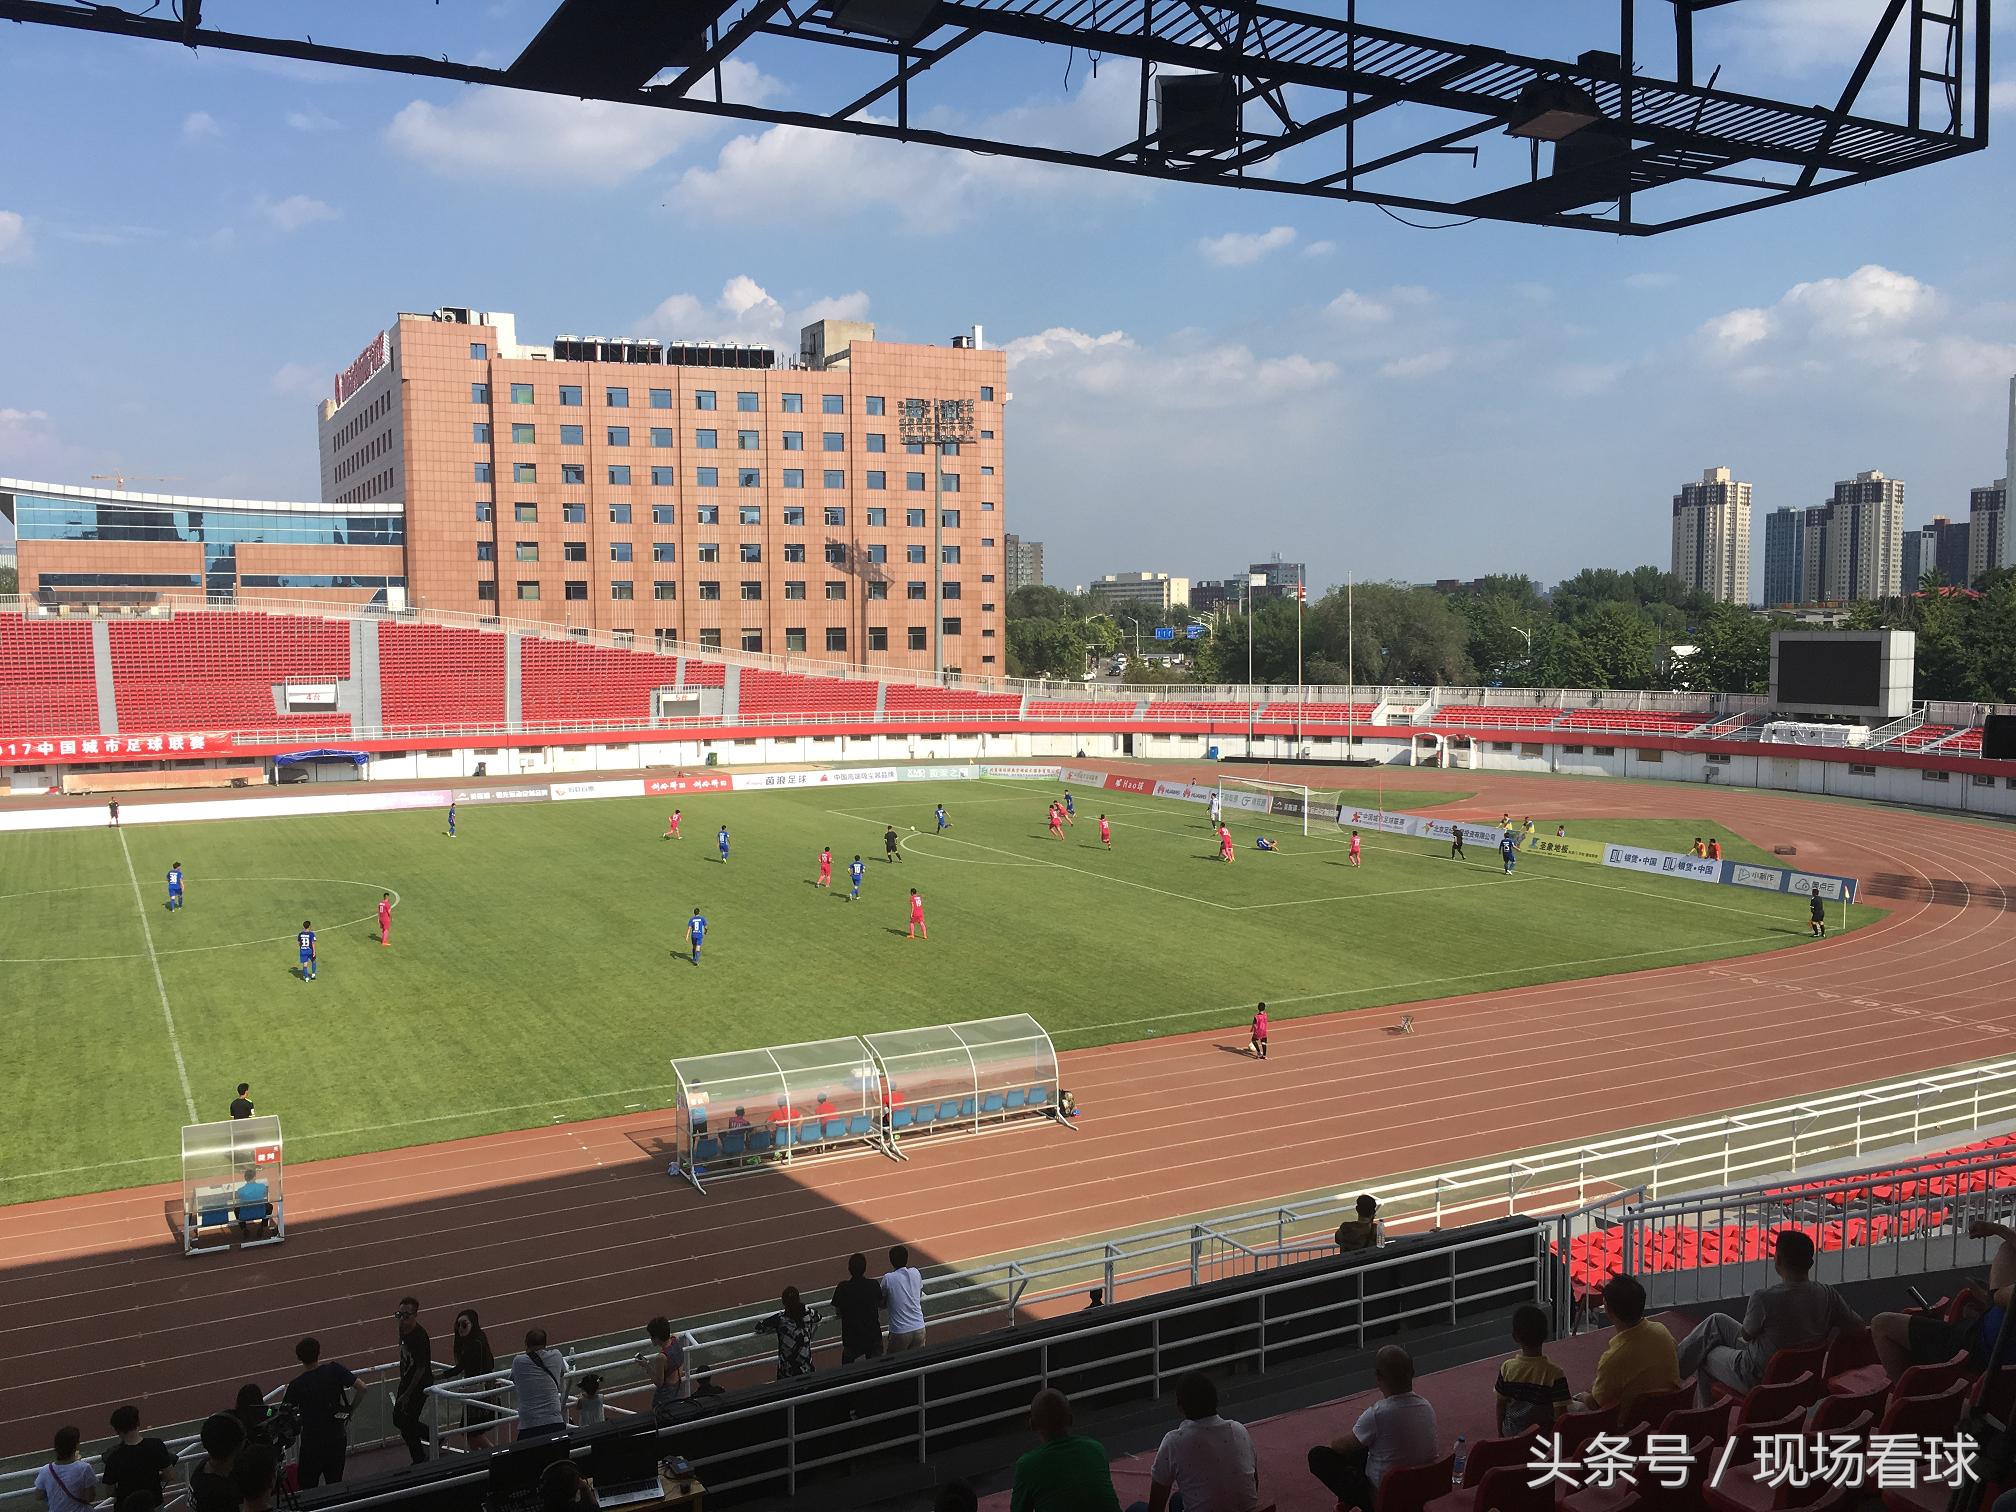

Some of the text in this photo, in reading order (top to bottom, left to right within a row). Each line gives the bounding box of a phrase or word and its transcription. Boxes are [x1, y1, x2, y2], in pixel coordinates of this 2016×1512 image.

[0, 736, 205, 756] 17中国城市足球联赛
